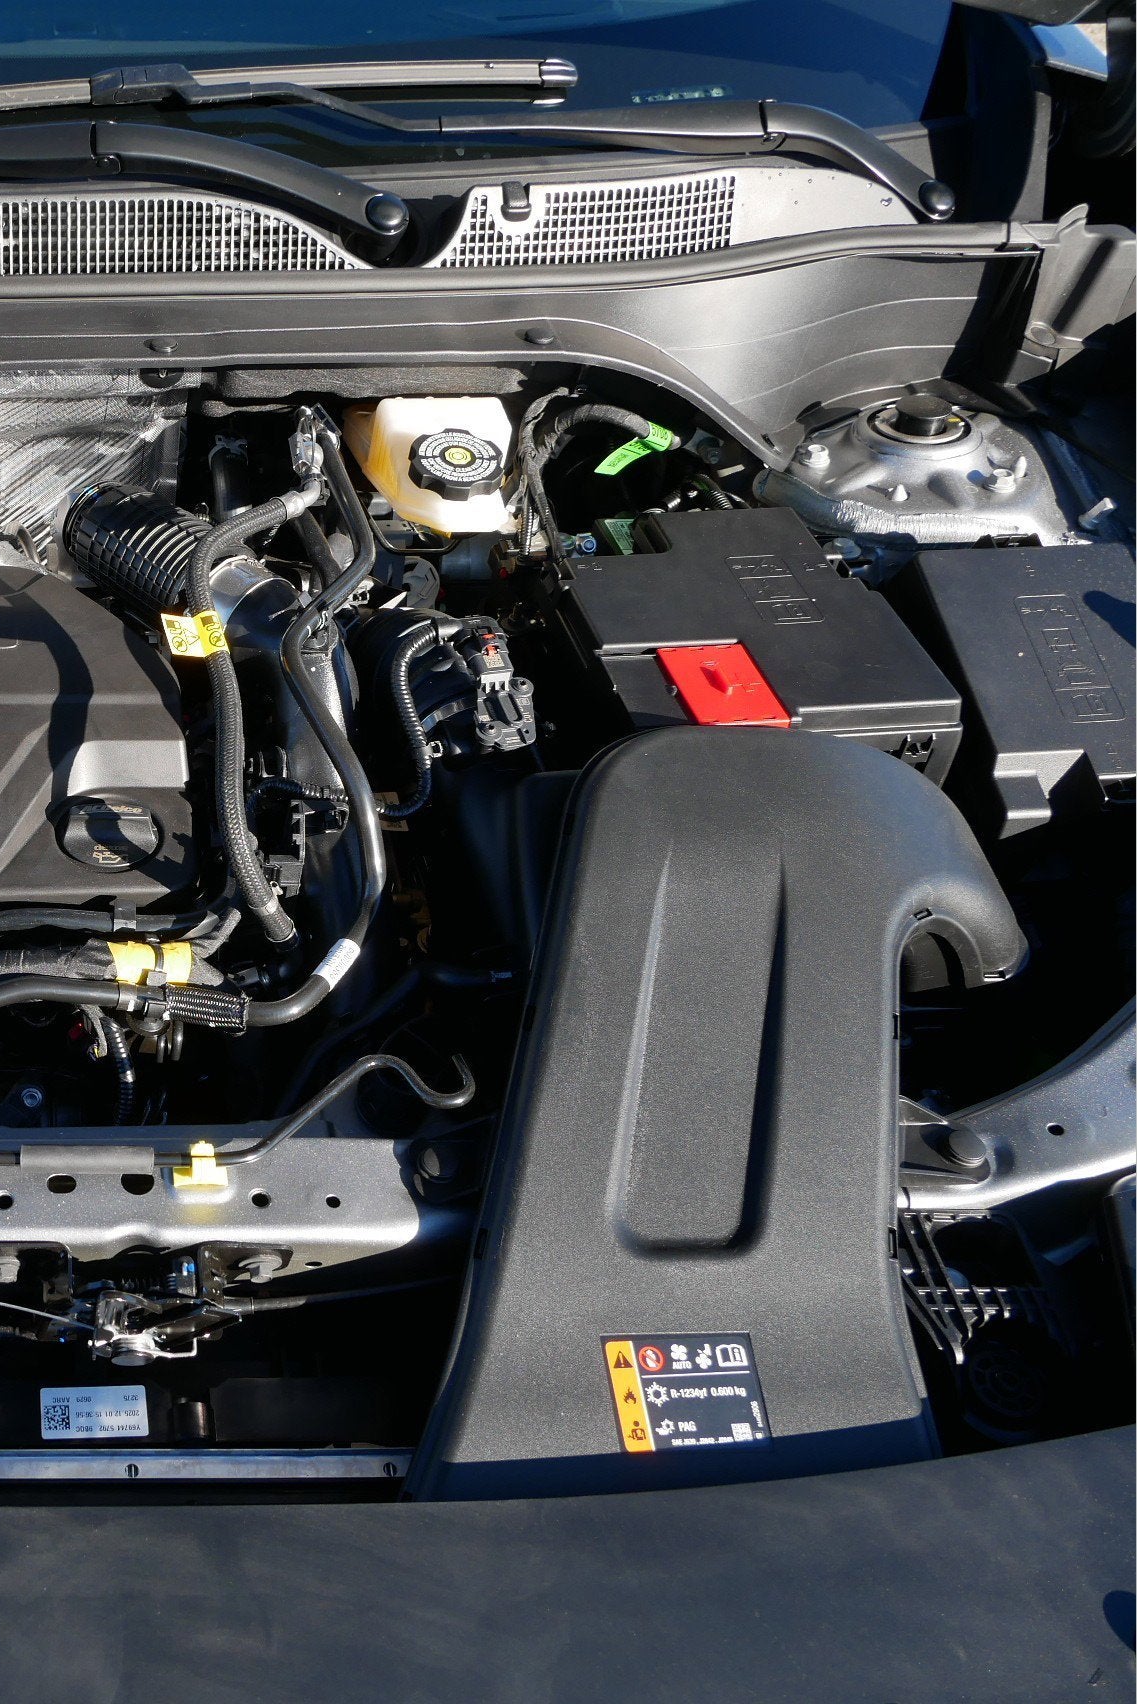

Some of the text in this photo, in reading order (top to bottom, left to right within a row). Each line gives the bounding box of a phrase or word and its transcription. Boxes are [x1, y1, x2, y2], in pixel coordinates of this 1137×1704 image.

[672, 1361, 692, 1369] AUTO
[670, 1386, 747, 1399] R-1234yf 0.600 kg
[678, 1421, 697, 1431] PAG
